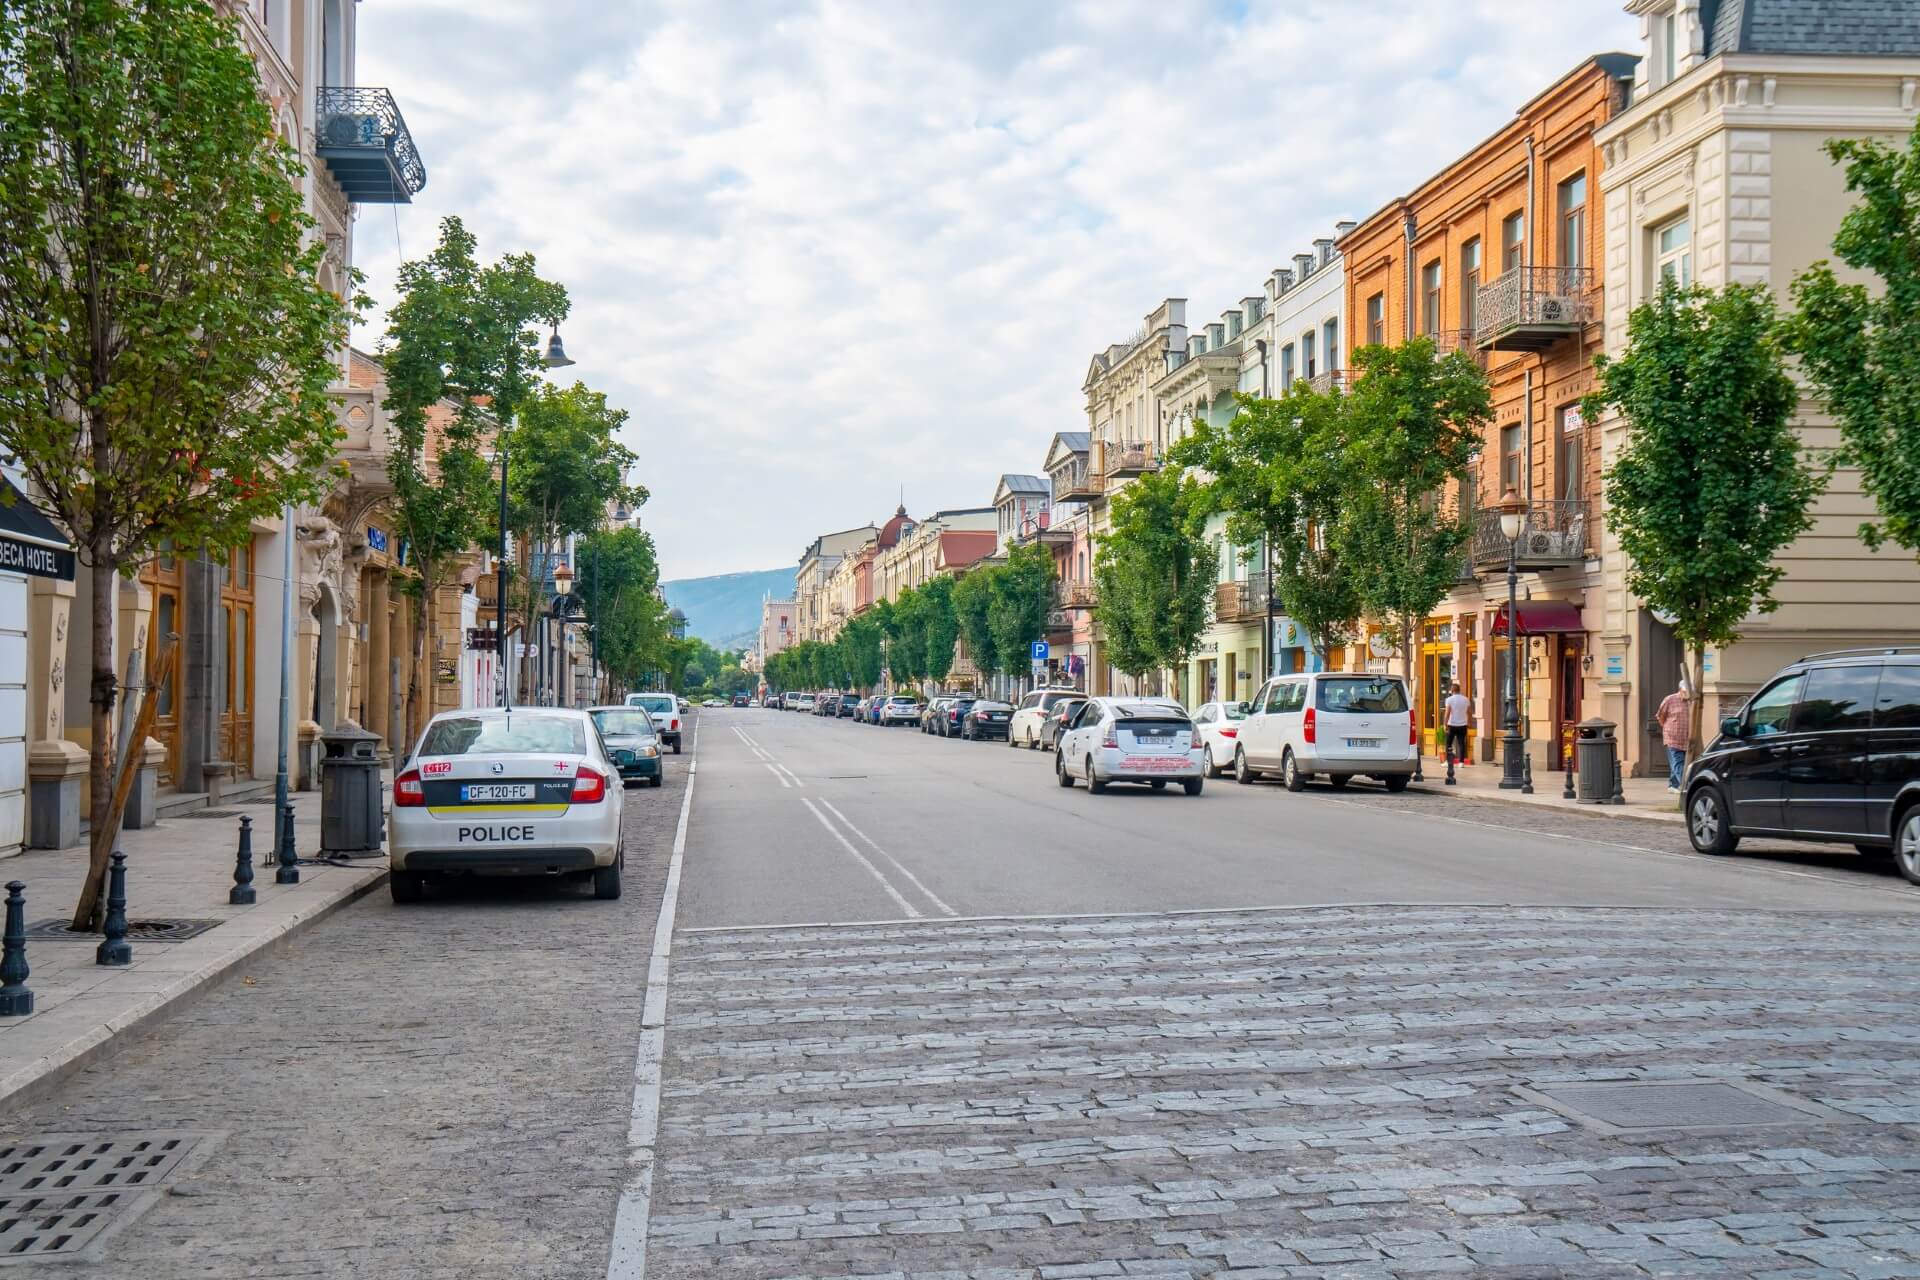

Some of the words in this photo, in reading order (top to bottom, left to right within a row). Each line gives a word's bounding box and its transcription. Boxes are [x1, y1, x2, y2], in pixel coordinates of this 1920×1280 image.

[26, 547, 58, 573] HOTEL
[1035, 644, 1045, 657] P
[470, 786, 527, 799] CF-120-FC
[458, 826, 535, 842] POLICE
